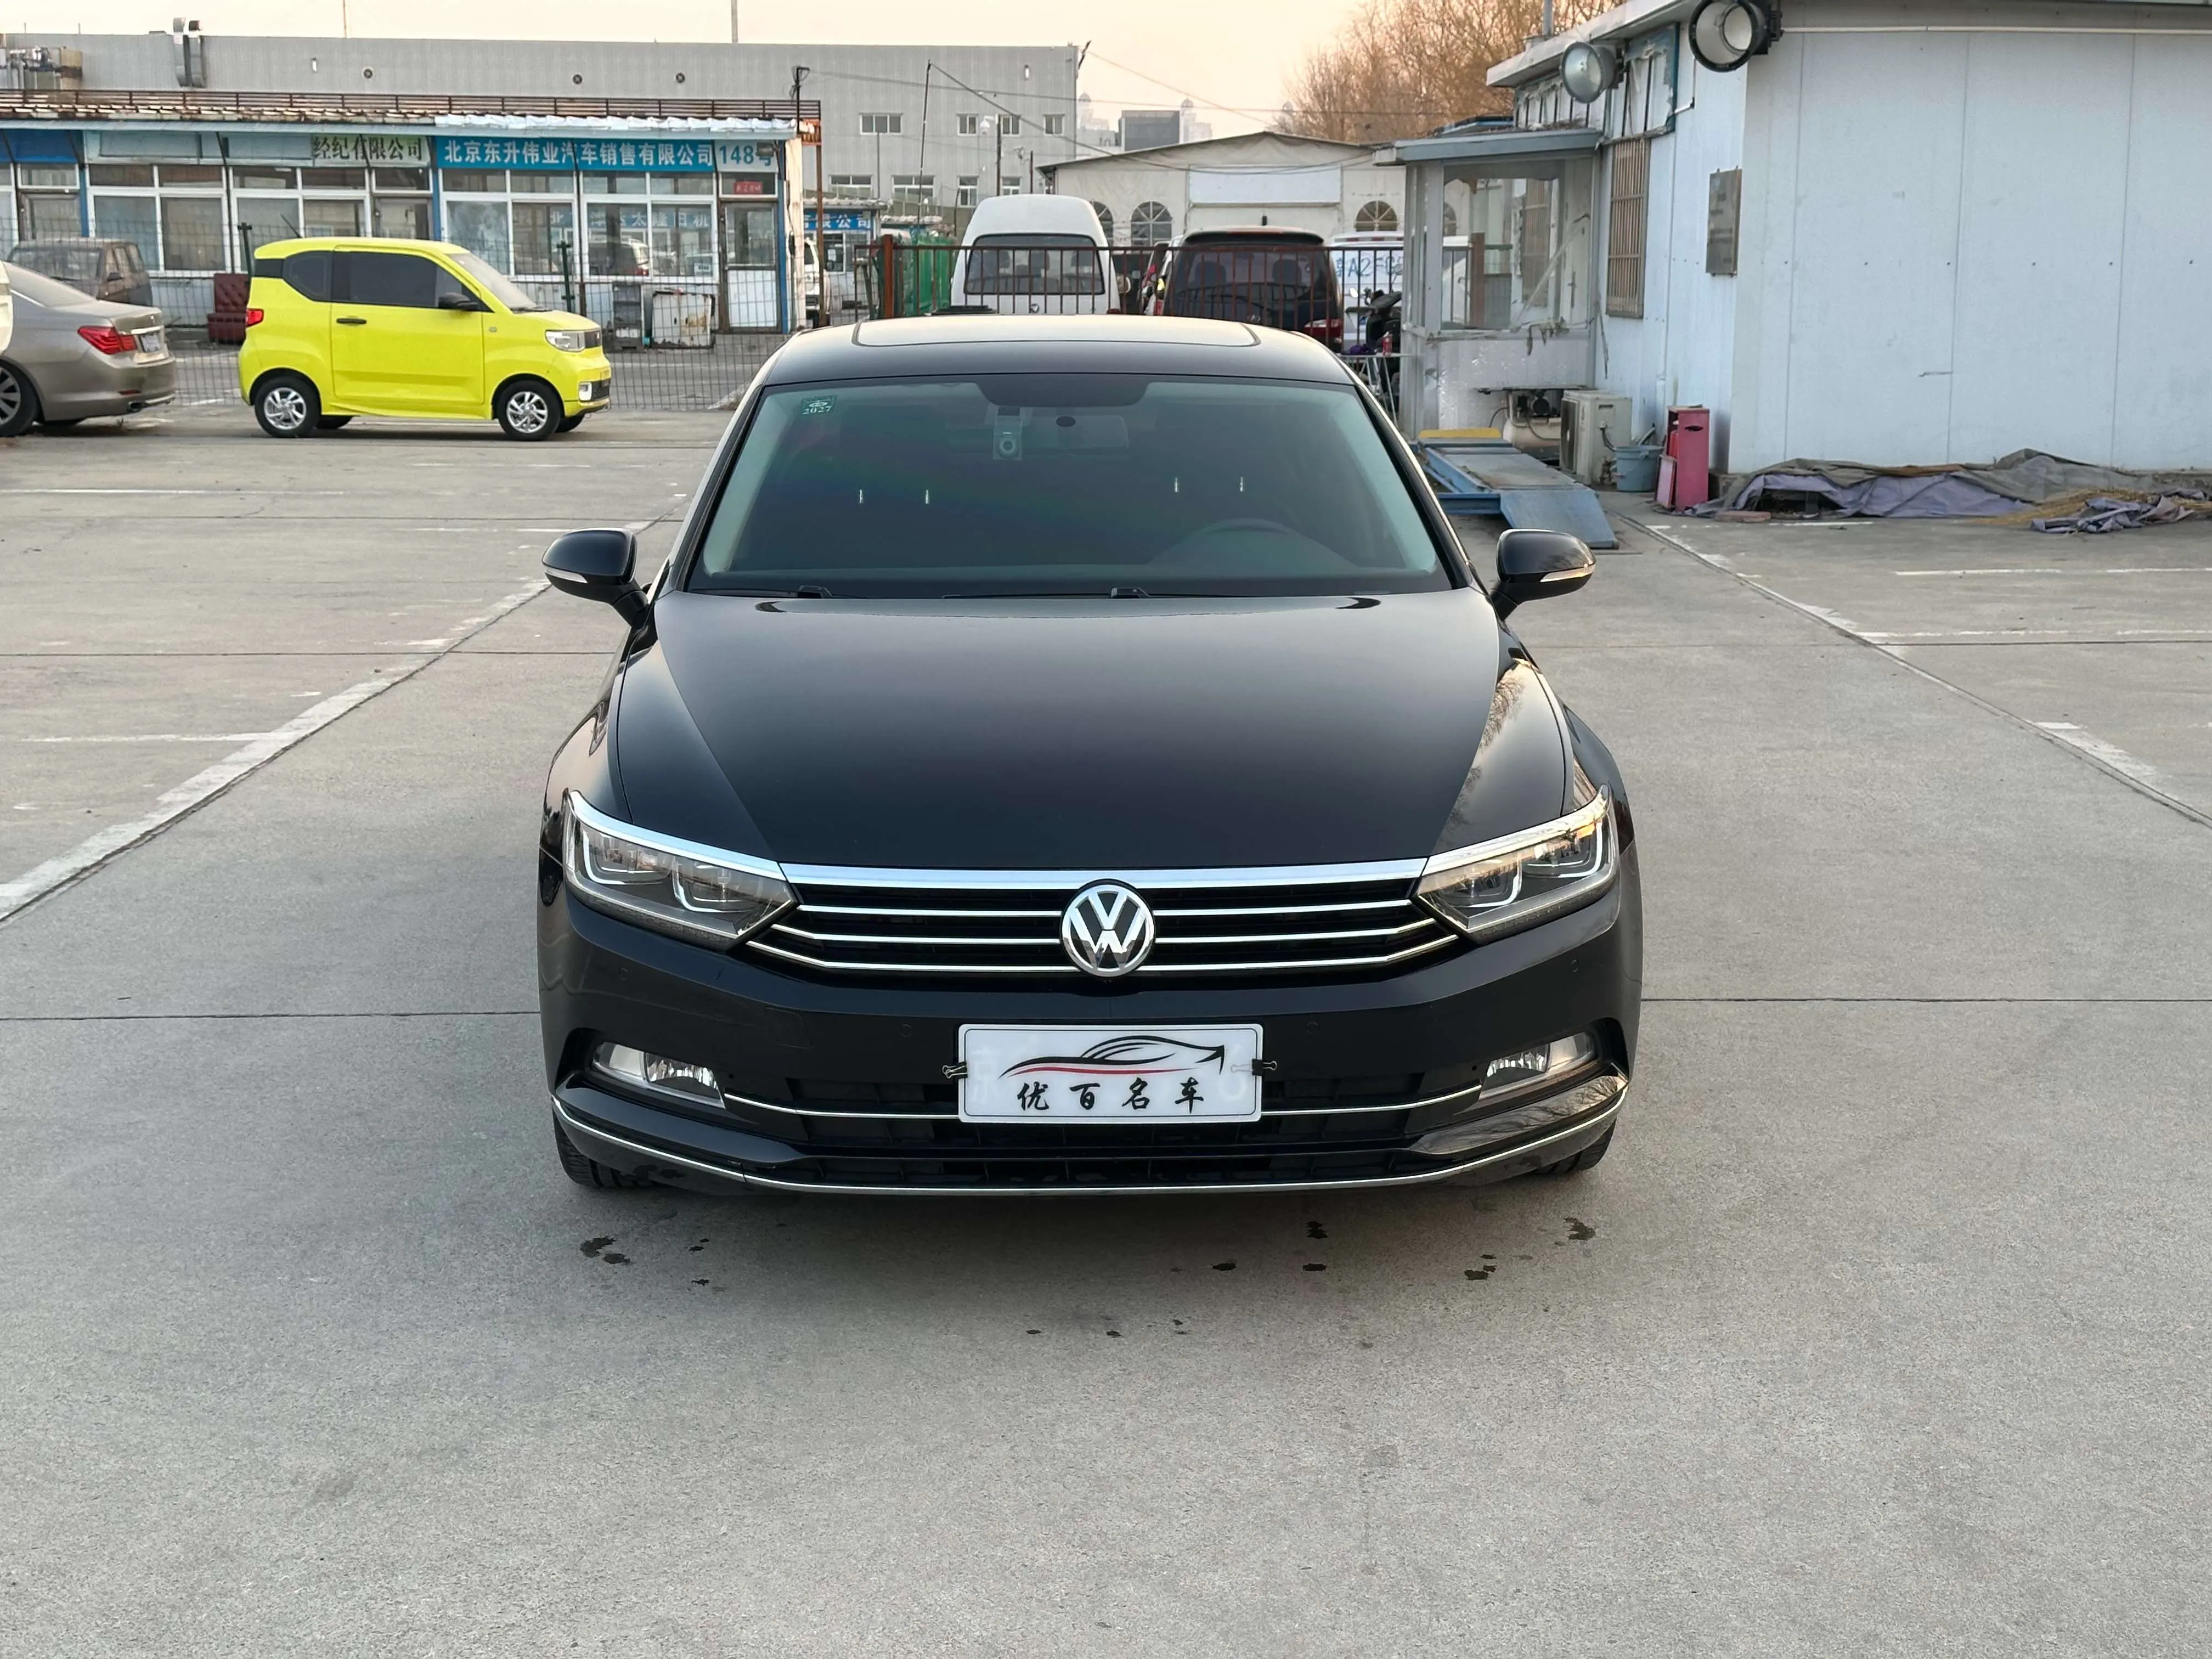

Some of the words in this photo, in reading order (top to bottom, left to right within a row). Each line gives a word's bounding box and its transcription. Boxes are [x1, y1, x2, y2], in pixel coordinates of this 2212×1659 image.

[444, 139, 713, 166] 北京东升伟业汽车销售有限公司
[803, 406, 832, 414] 2027
[1069, 889, 1148, 972] VW
[1017, 1077, 1205, 1115] 优百名车
